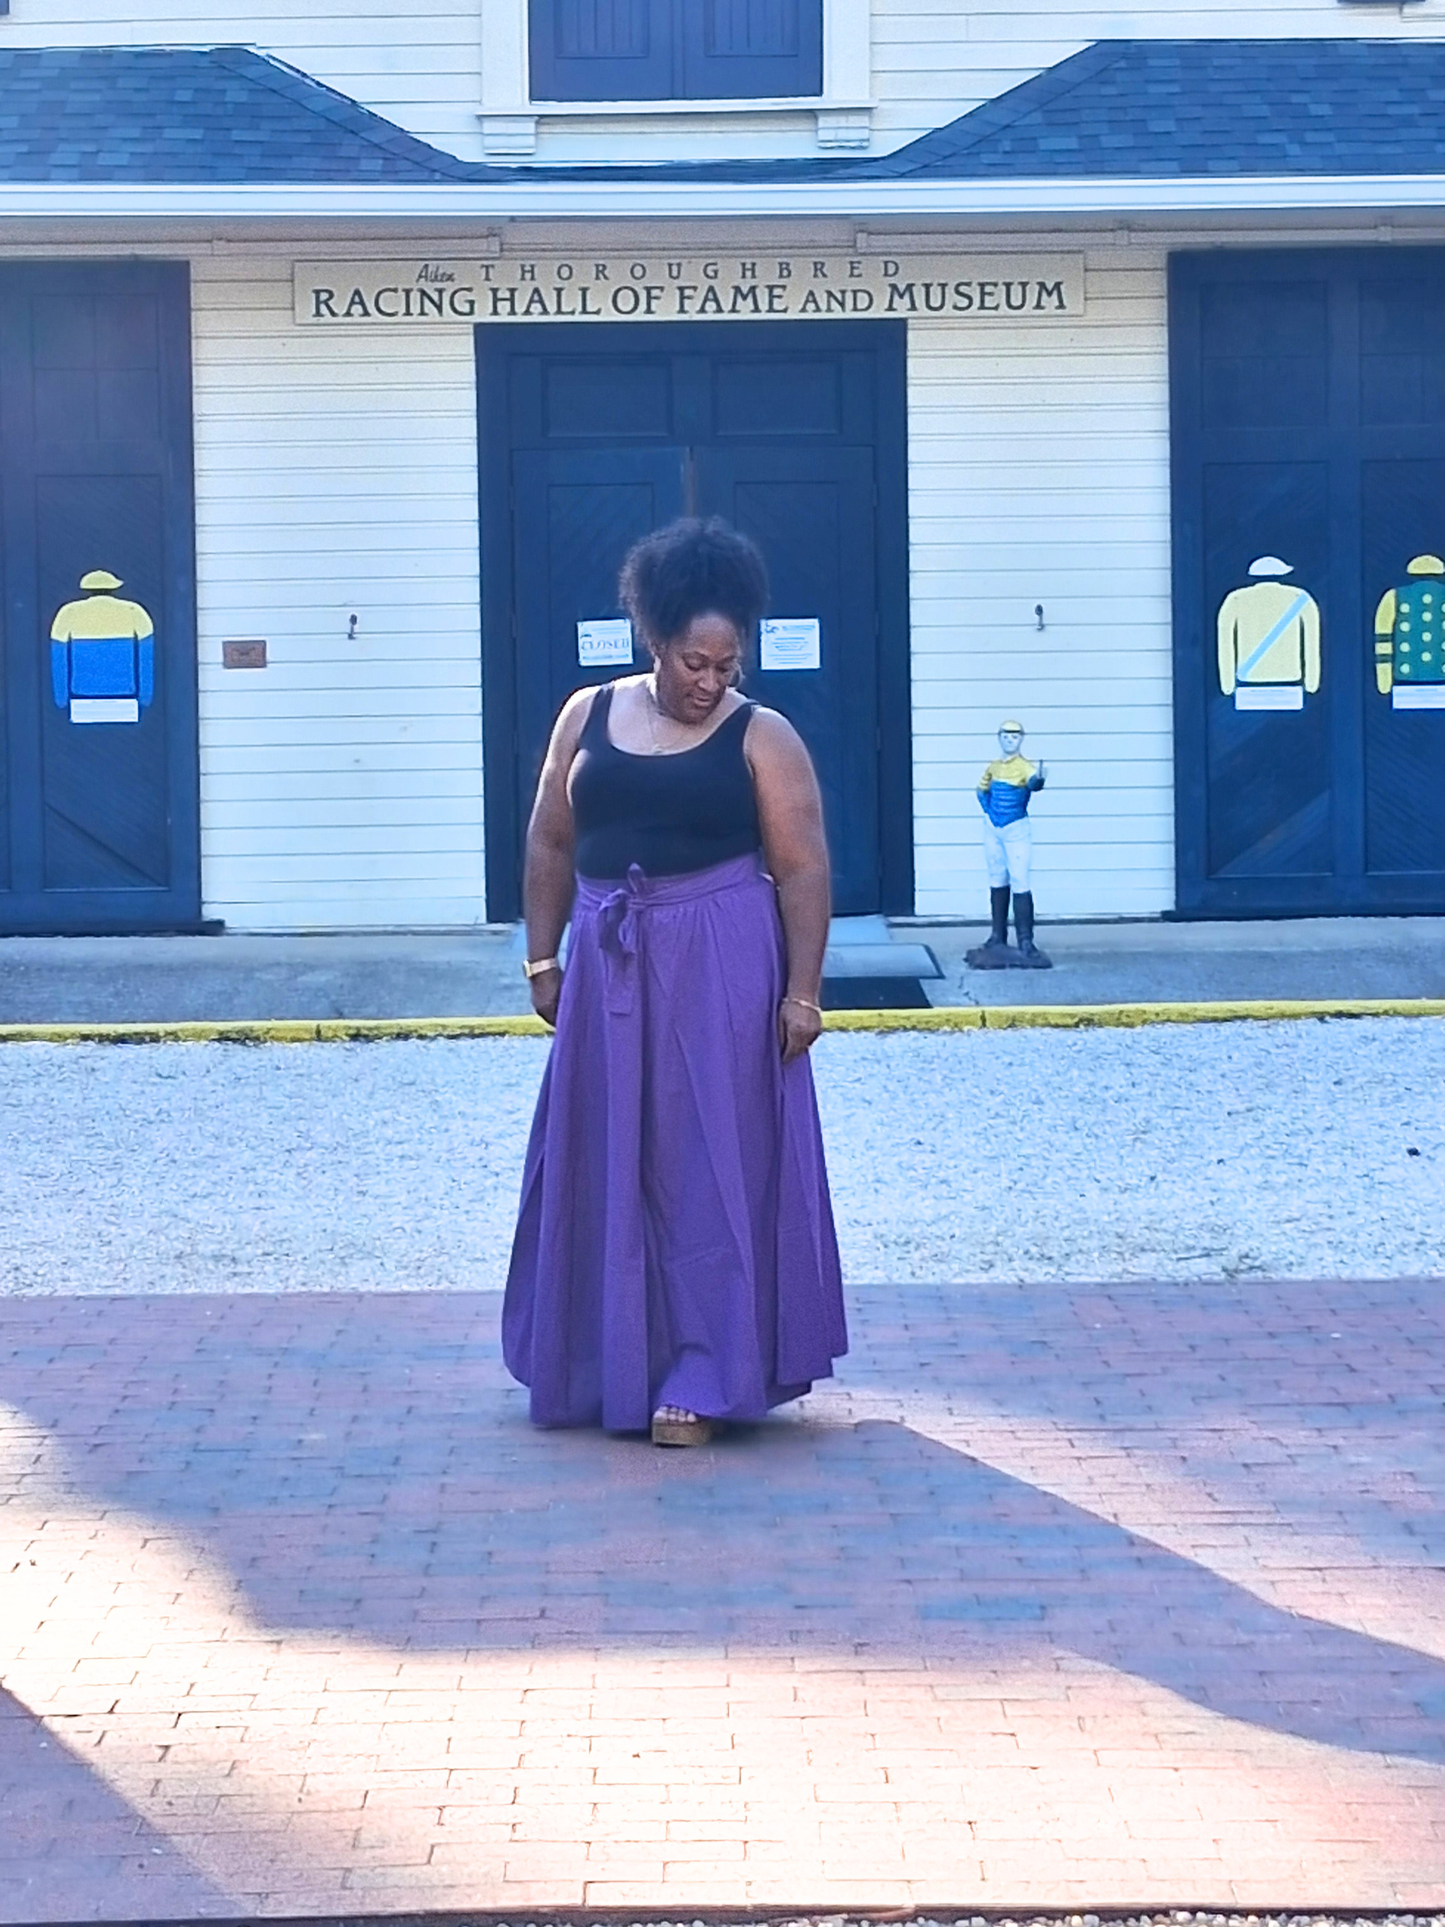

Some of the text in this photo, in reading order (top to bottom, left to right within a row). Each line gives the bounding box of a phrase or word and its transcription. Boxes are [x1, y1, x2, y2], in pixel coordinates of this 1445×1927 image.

[481, 260, 899, 282] THOROUGHBRED
[312, 281, 1067, 318] RACING HALL OF FAME AND MUSEUM
